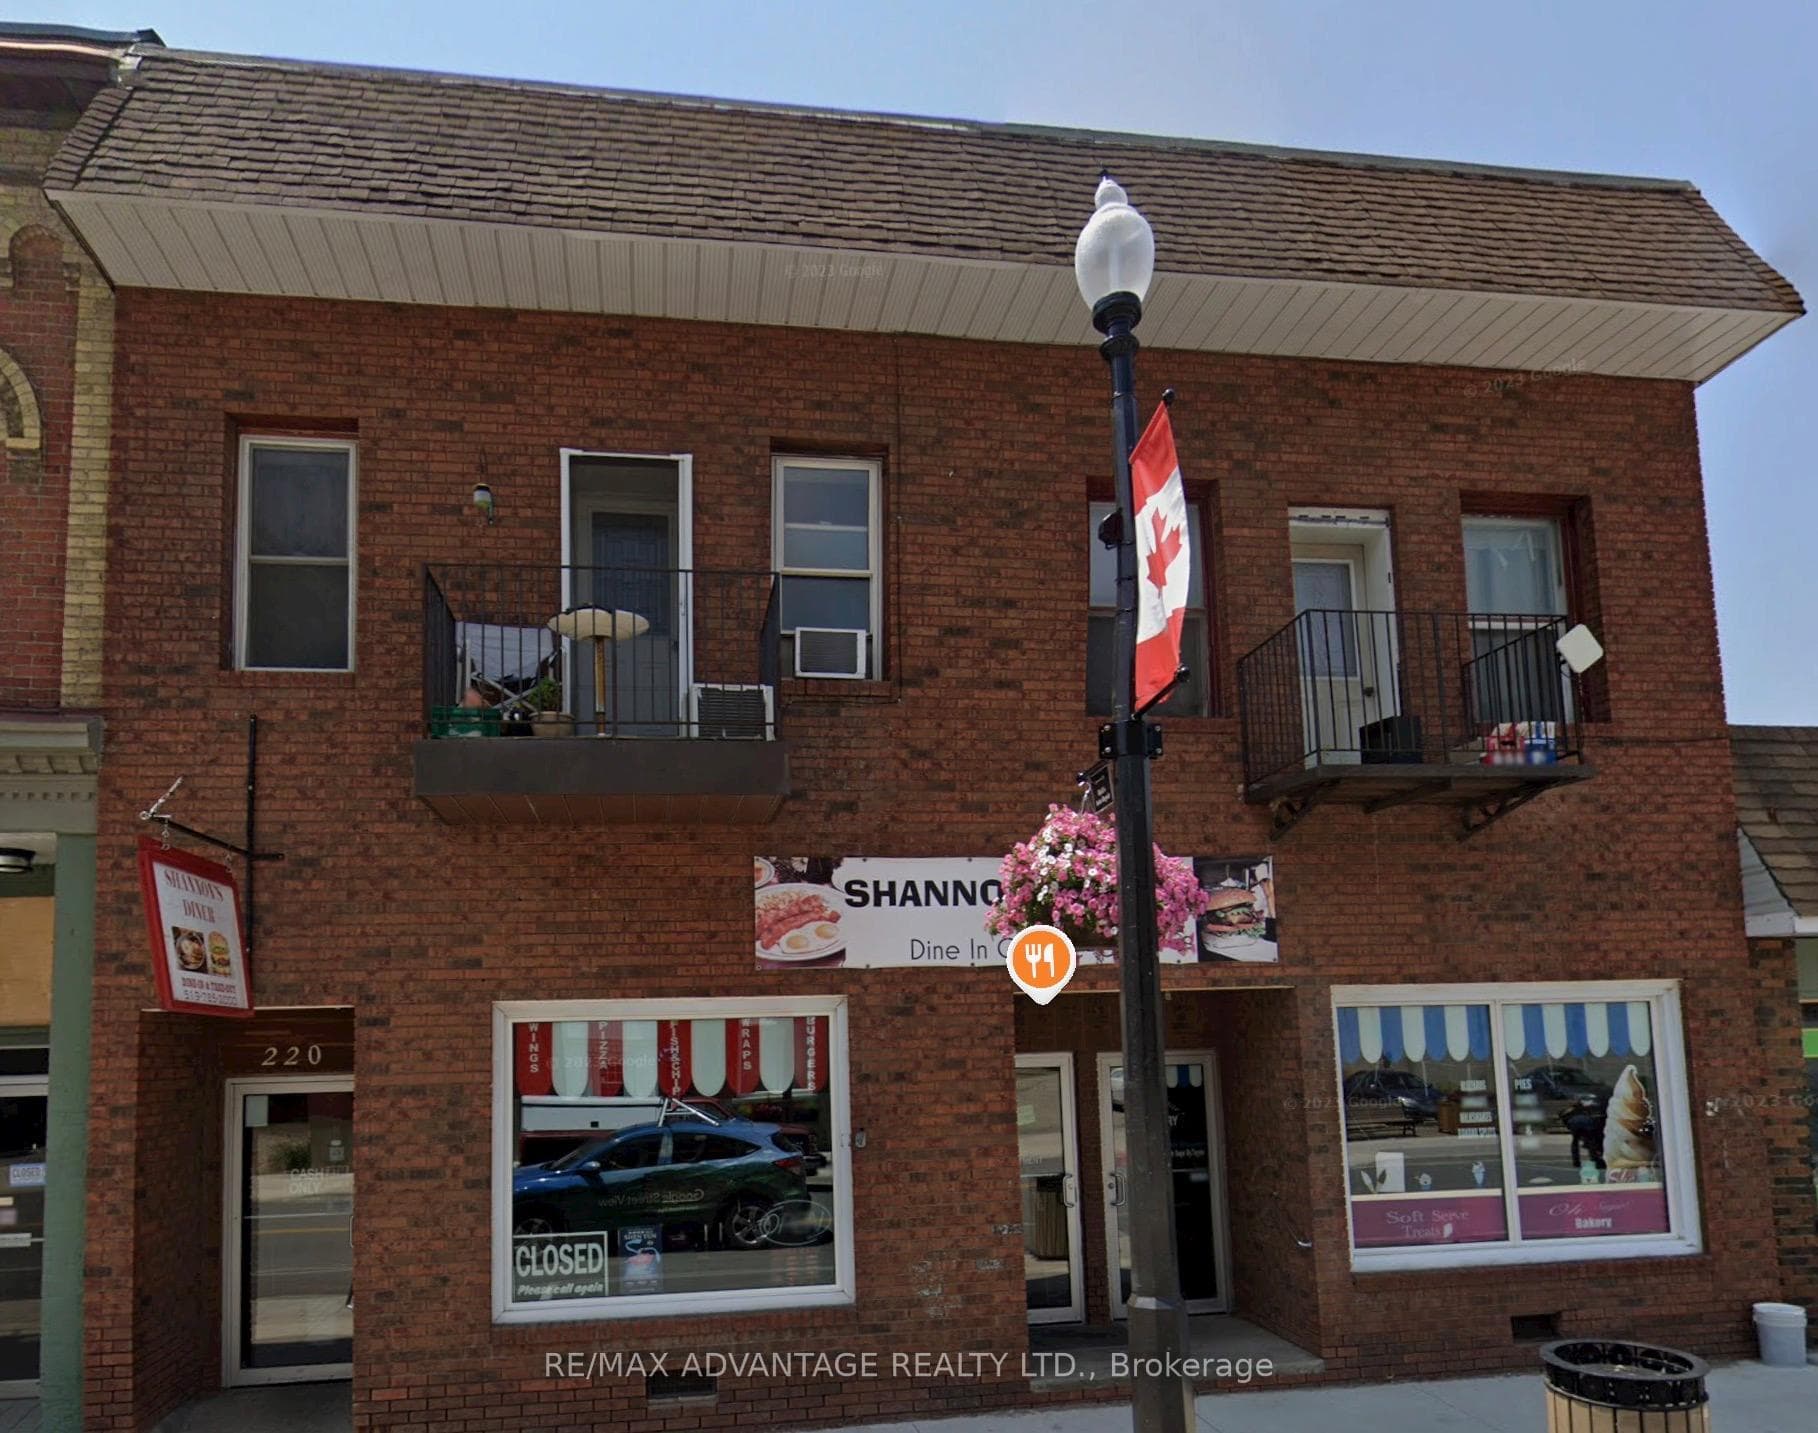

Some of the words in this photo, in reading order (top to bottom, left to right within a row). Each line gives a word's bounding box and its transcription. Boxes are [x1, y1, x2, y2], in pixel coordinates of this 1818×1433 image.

[183, 899, 215, 923] DINER
[911, 939, 960, 960] Dine
[971, 938, 988, 960] In
[261, 1044, 321, 1066] 220
[528, 1023, 539, 1073] WINGS
[598, 1022, 609, 1070] PIZZA
[741, 1018, 752, 1071] WRAPS
[806, 1016, 816, 1091] BURGERS
[290, 1168, 324, 1181] CASH
[289, 1182, 321, 1194] ONLY
[1386, 1210, 1424, 1225] Soft
[1431, 1209, 1469, 1223] Serve
[1575, 1217, 1613, 1229] Bakery
[1401, 1225, 1441, 1239] Treats
[515, 1242, 604, 1278] CLOSED
[518, 1284, 552, 1296] Please
[552, 1282, 574, 1294] call
[574, 1281, 604, 1296] again
